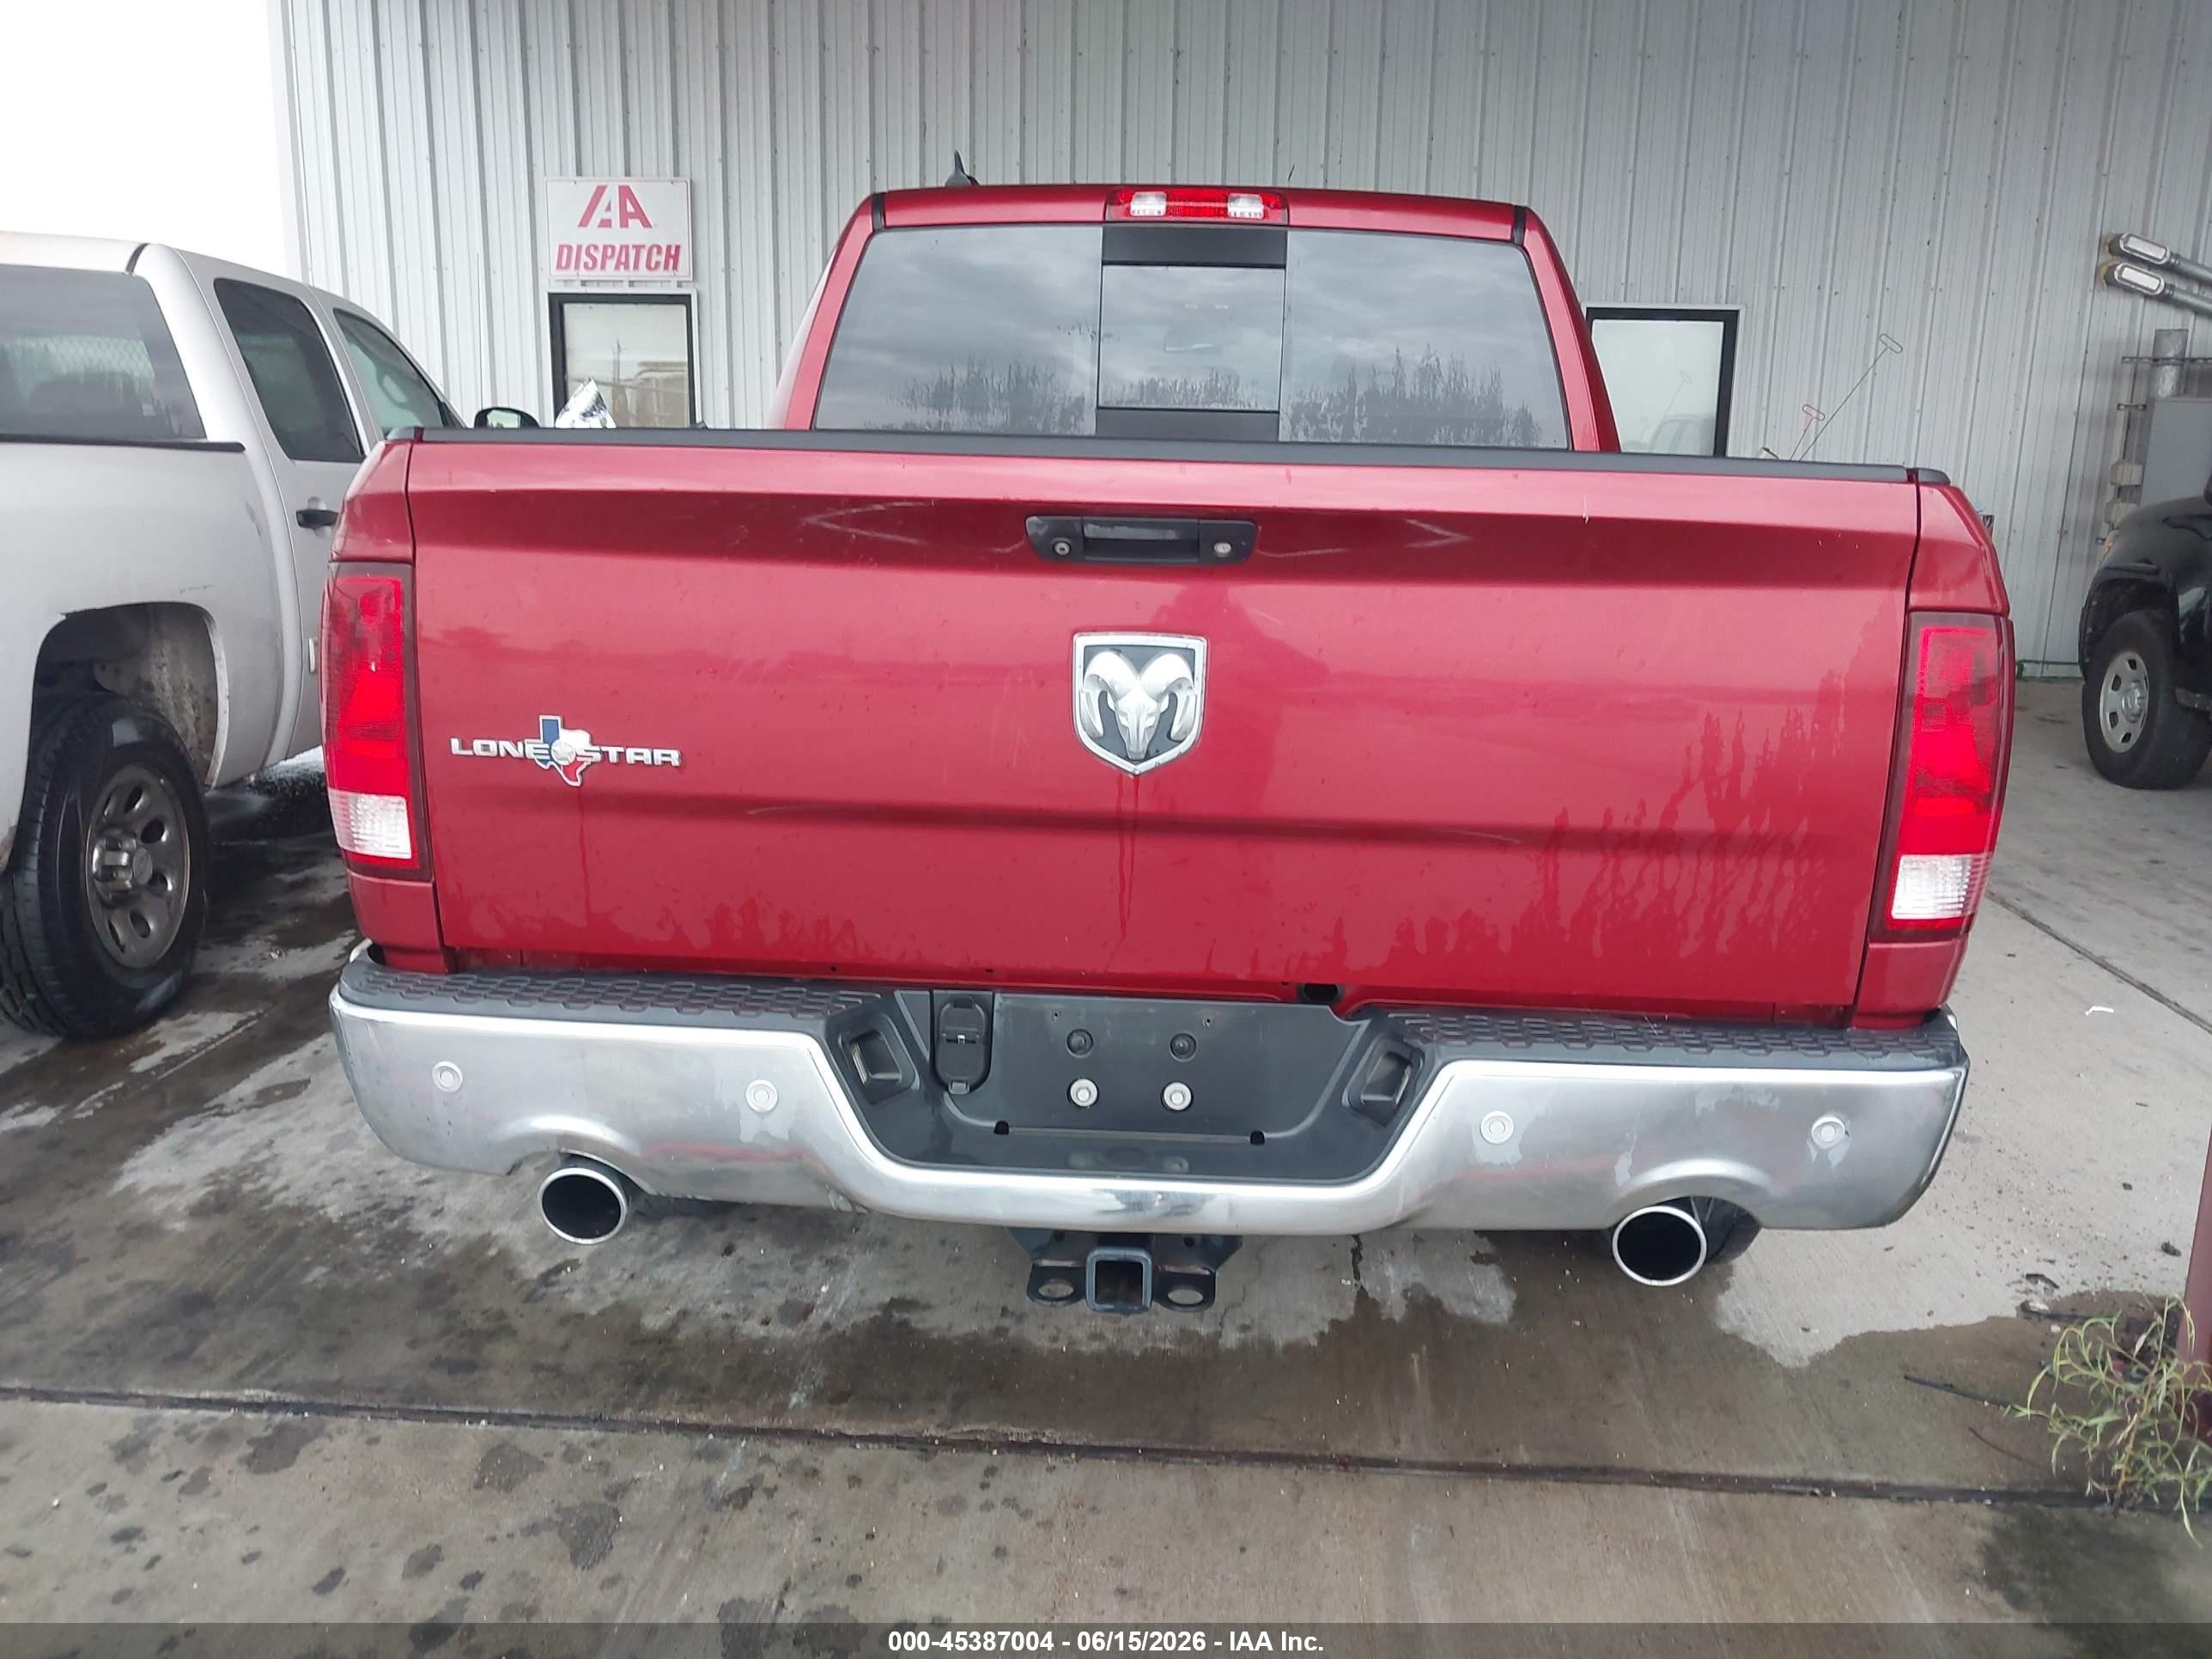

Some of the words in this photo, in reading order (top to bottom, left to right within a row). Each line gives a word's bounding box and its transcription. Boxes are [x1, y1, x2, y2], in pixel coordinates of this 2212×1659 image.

[556, 244, 681, 271] DISPATCH
[450, 738, 550, 760] LONE
[575, 745, 682, 767] STAR
